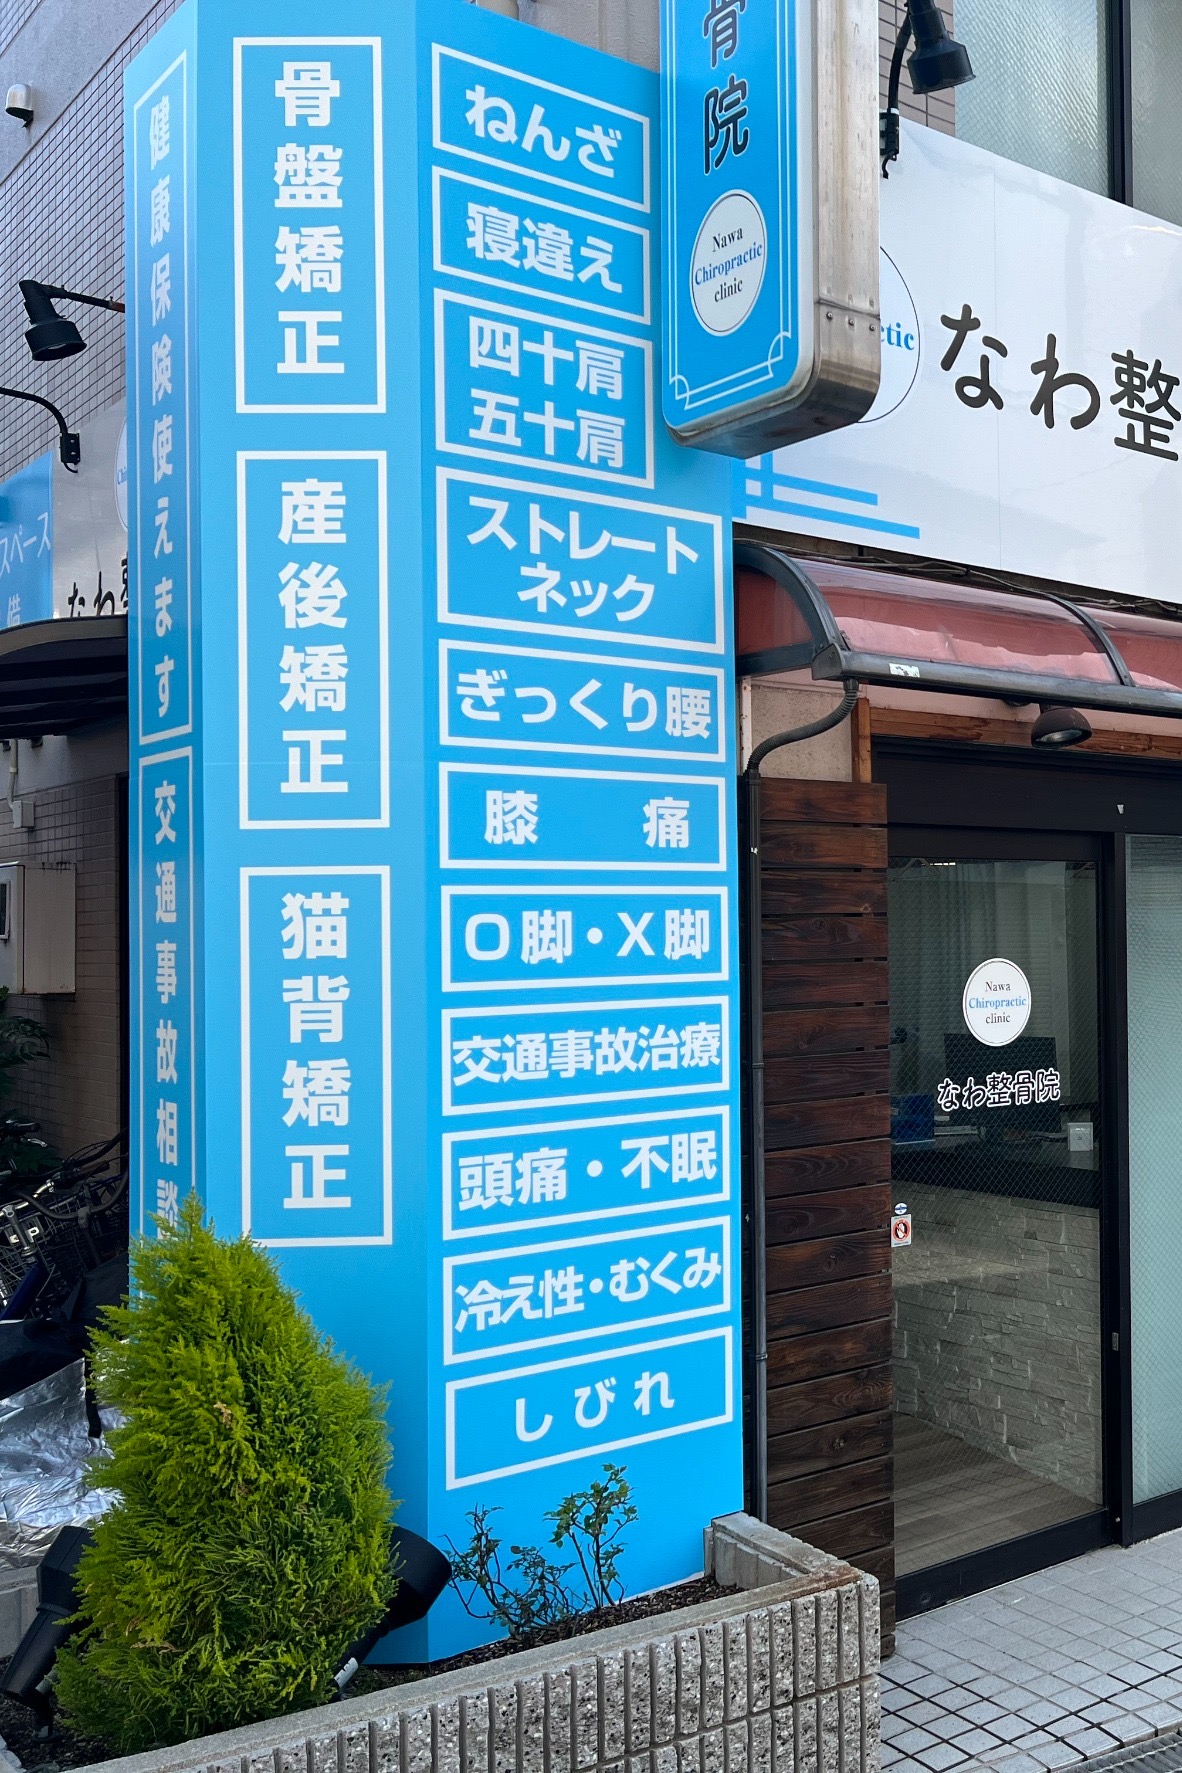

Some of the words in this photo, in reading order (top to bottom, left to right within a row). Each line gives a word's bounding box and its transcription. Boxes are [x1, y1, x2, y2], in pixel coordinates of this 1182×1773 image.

[465, 85, 623, 180] ねんざ
[274, 61, 345, 375] 骨盤矯正
[466, 202, 623, 294] 寝違え
[712, 227, 743, 252] Nawa
[694, 242, 763, 285] Chiropractic
[714, 277, 743, 302] clinic
[469, 315, 625, 401] 四十肩
[150, 94, 174, 719] 健康保険使えます
[468, 387, 625, 469] 五十肩
[466, 494, 699, 575] ストレート
[519, 561, 656, 622] ネック
[278, 477, 348, 795] 産後矯正
[455, 668, 711, 740] ぎっくり腰
[154, 780, 179, 1240] 交通事故相談
[968, 996, 1027, 1010] Chiropractic
[985, 980, 1011, 992] Nawa
[985, 1013, 1011, 1024] clinic
[282, 891, 351, 1209] 猫背矯正
[452, 1020, 722, 1088] 交通事故治療
[936, 1068, 1061, 1112] なわ整骨院
[457, 1129, 718, 1211] 頭痛・不眠
[454, 1247, 722, 1333] 冷え性・むくみ
[515, 1371, 675, 1443] しびれ
